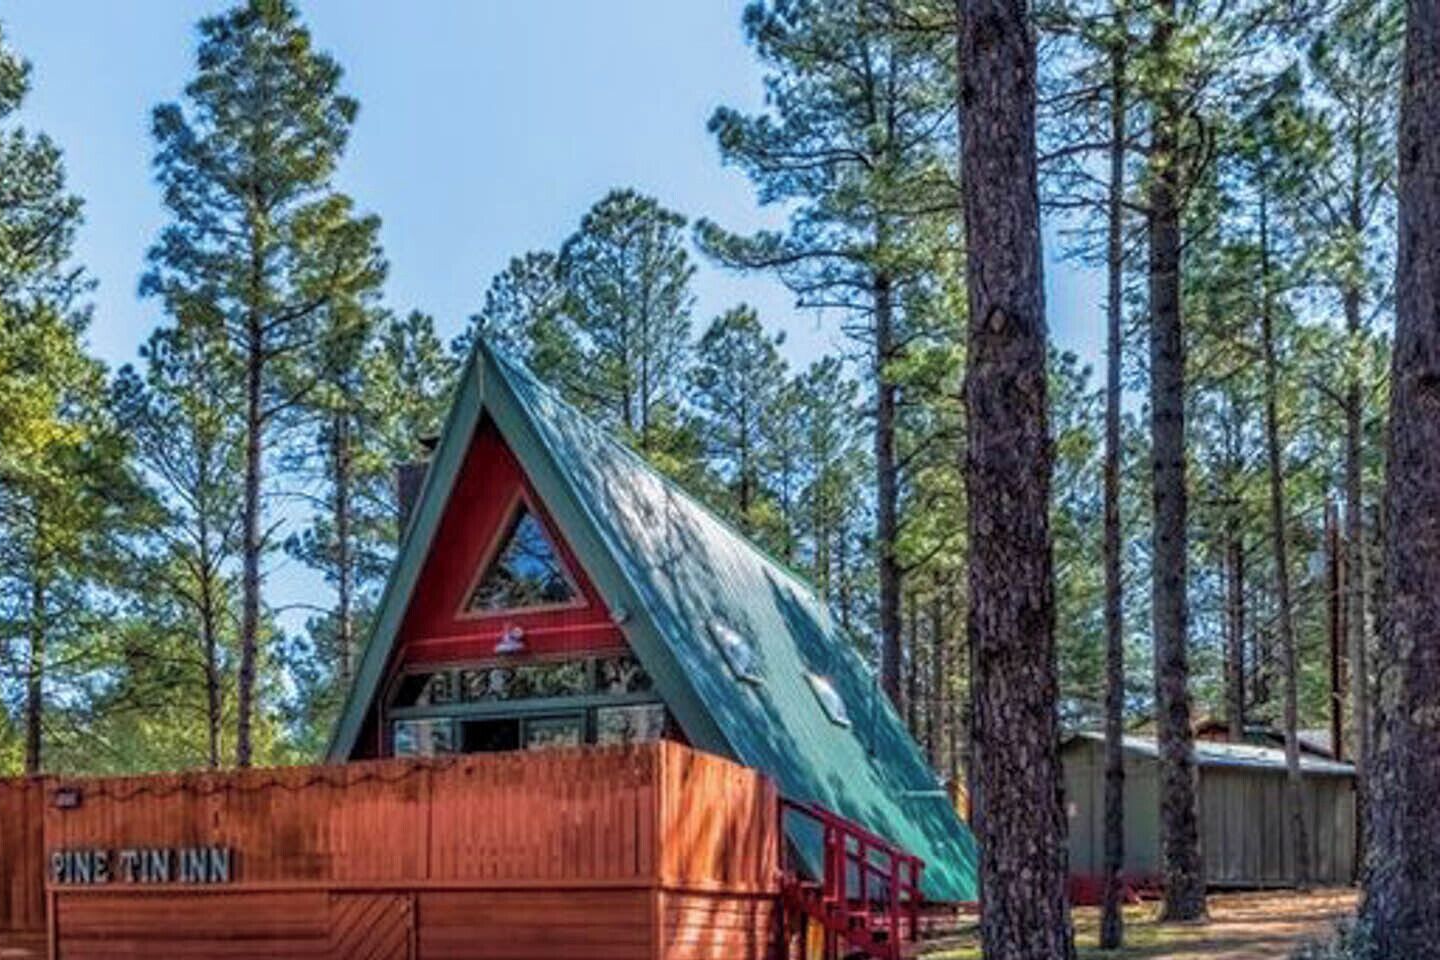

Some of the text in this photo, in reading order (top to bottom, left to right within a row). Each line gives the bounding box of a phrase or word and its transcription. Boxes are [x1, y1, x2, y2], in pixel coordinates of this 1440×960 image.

[51, 848, 229, 883] PINE TIN INN
